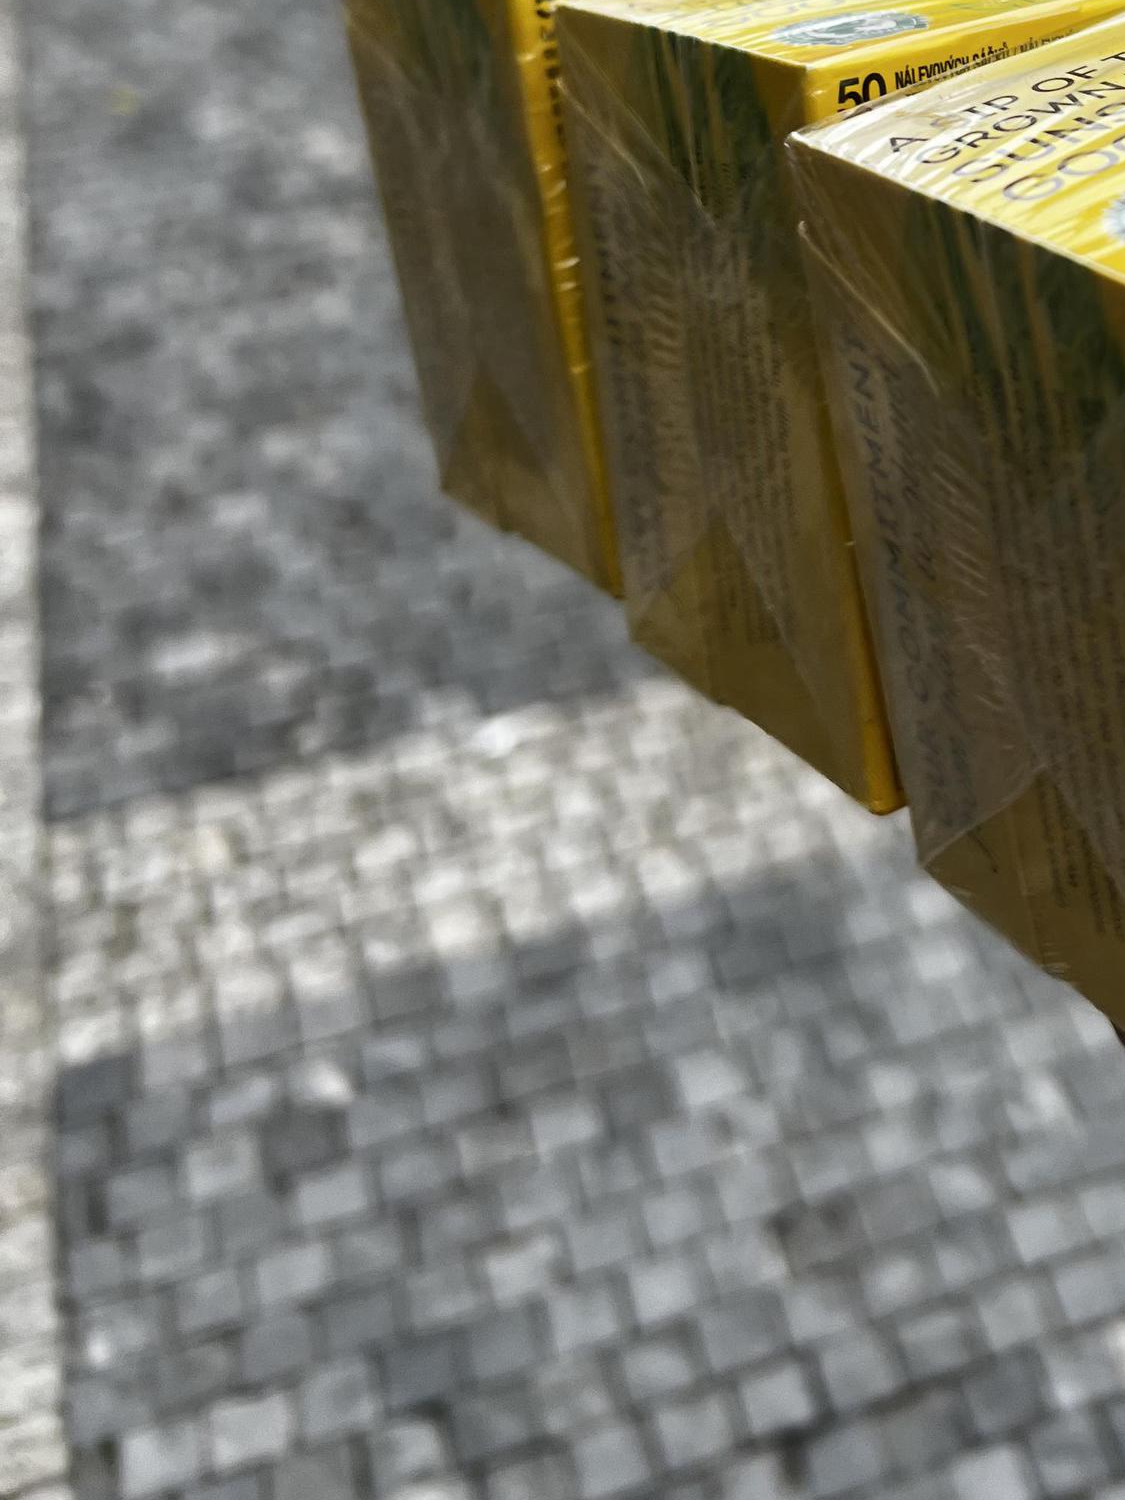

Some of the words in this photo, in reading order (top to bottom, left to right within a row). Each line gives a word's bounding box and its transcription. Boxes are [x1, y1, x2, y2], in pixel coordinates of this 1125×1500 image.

[836, 71, 889, 107] 50
[887, 133, 930, 154] A
[1031, 61, 1112, 93] OF
[917, 79, 1121, 167] GROWN
